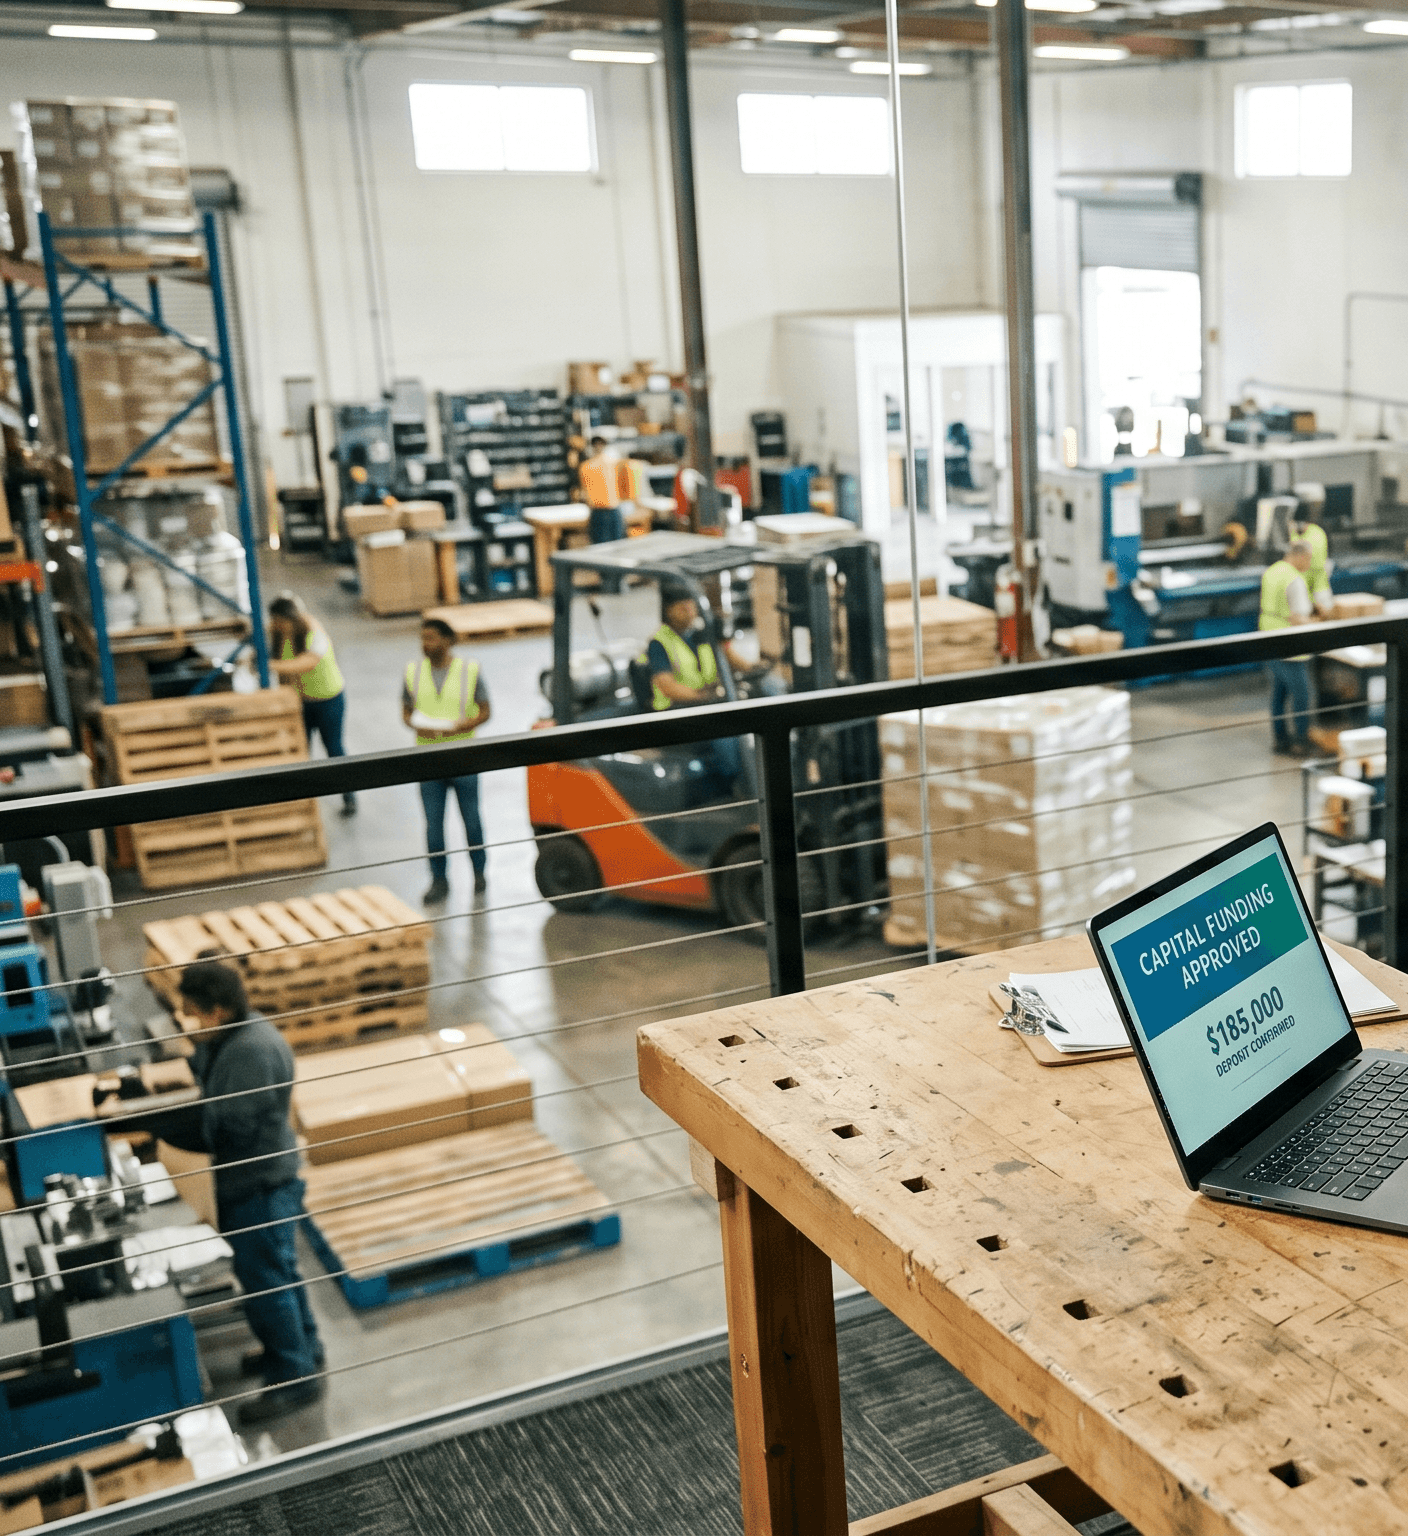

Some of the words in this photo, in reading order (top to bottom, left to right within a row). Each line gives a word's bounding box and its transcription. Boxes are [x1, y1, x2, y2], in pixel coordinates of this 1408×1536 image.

[1139, 924, 1206, 975] CAPITAL
[1206, 883, 1274, 937] FUNDING
[1181, 926, 1261, 989] APPROVED
[1206, 986, 1284, 1055] $185,000
